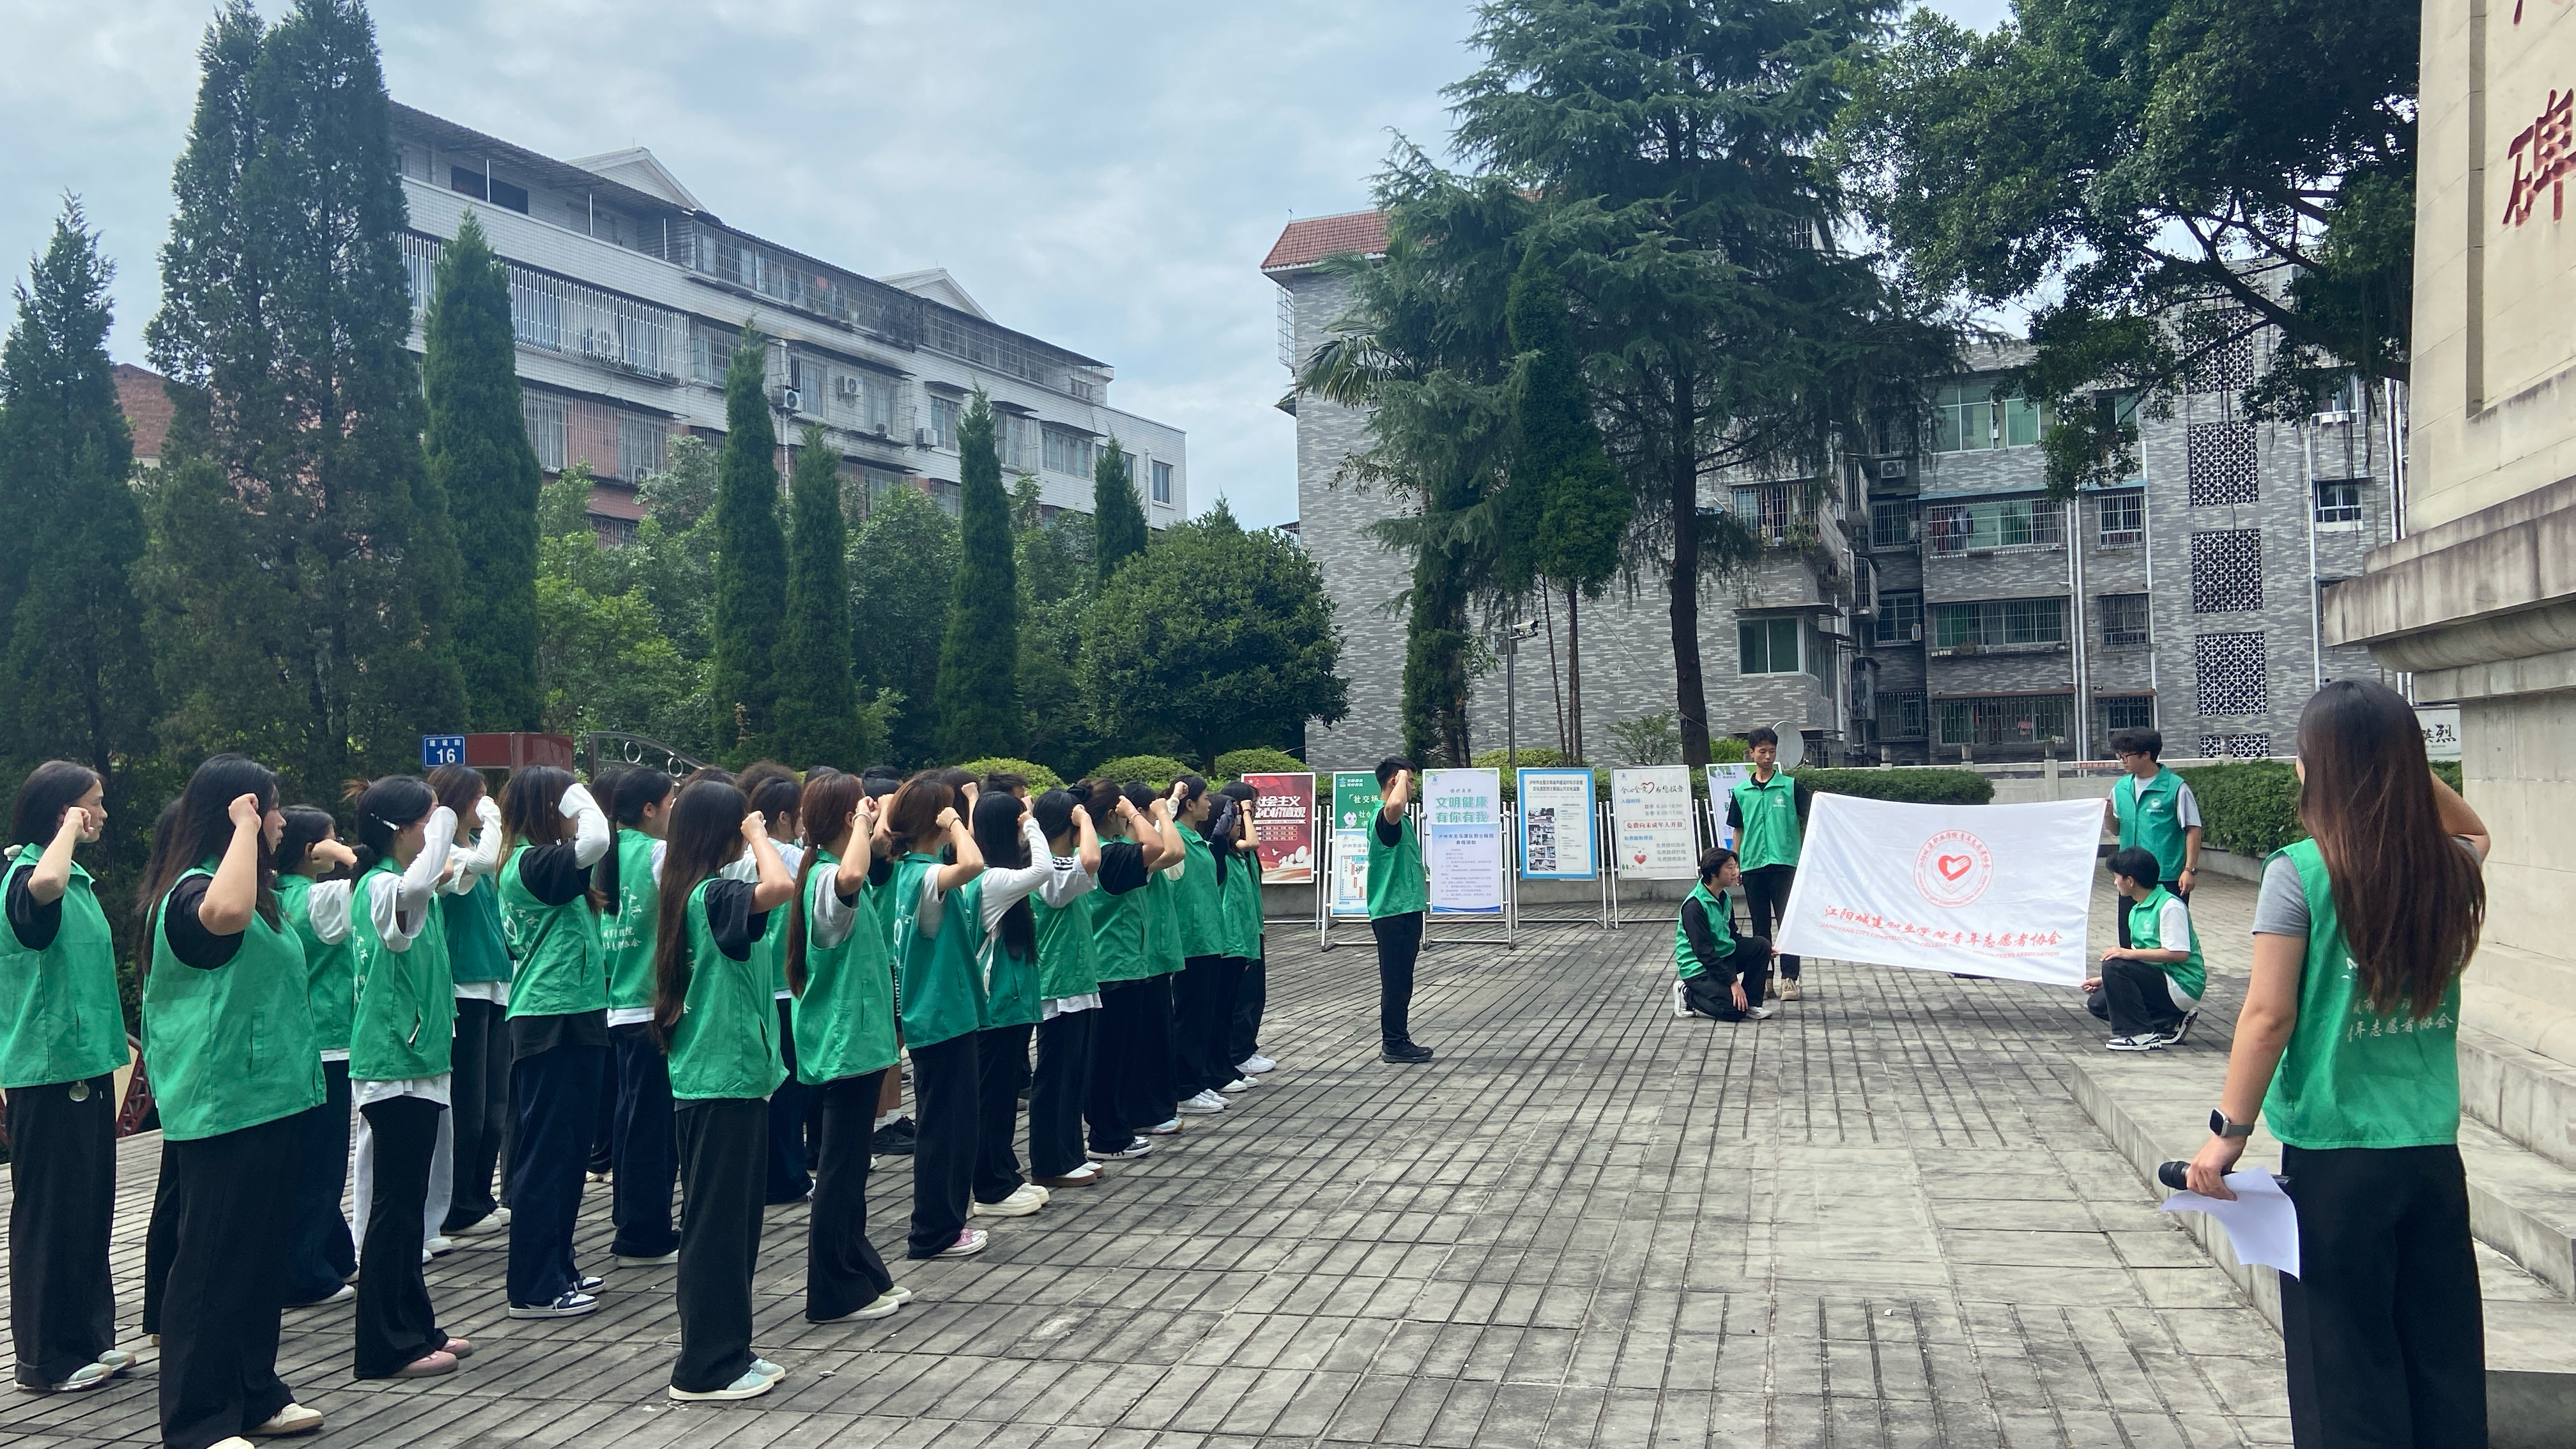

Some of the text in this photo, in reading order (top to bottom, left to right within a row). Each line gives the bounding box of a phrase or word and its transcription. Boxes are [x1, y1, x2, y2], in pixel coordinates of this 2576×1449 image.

[2502, 88, 2576, 227] 碑
[436, 748, 456, 763] 16
[1435, 796, 1489, 809] 文明健康
[1436, 811, 1489, 823] 有你有我
[1819, 923, 1855, 934] JIANGYANG
[1870, 933, 1919, 946] CONSTRUCTION
[1824, 905, 2064, 948] 江阳城建职业学院青年志愿者协会
